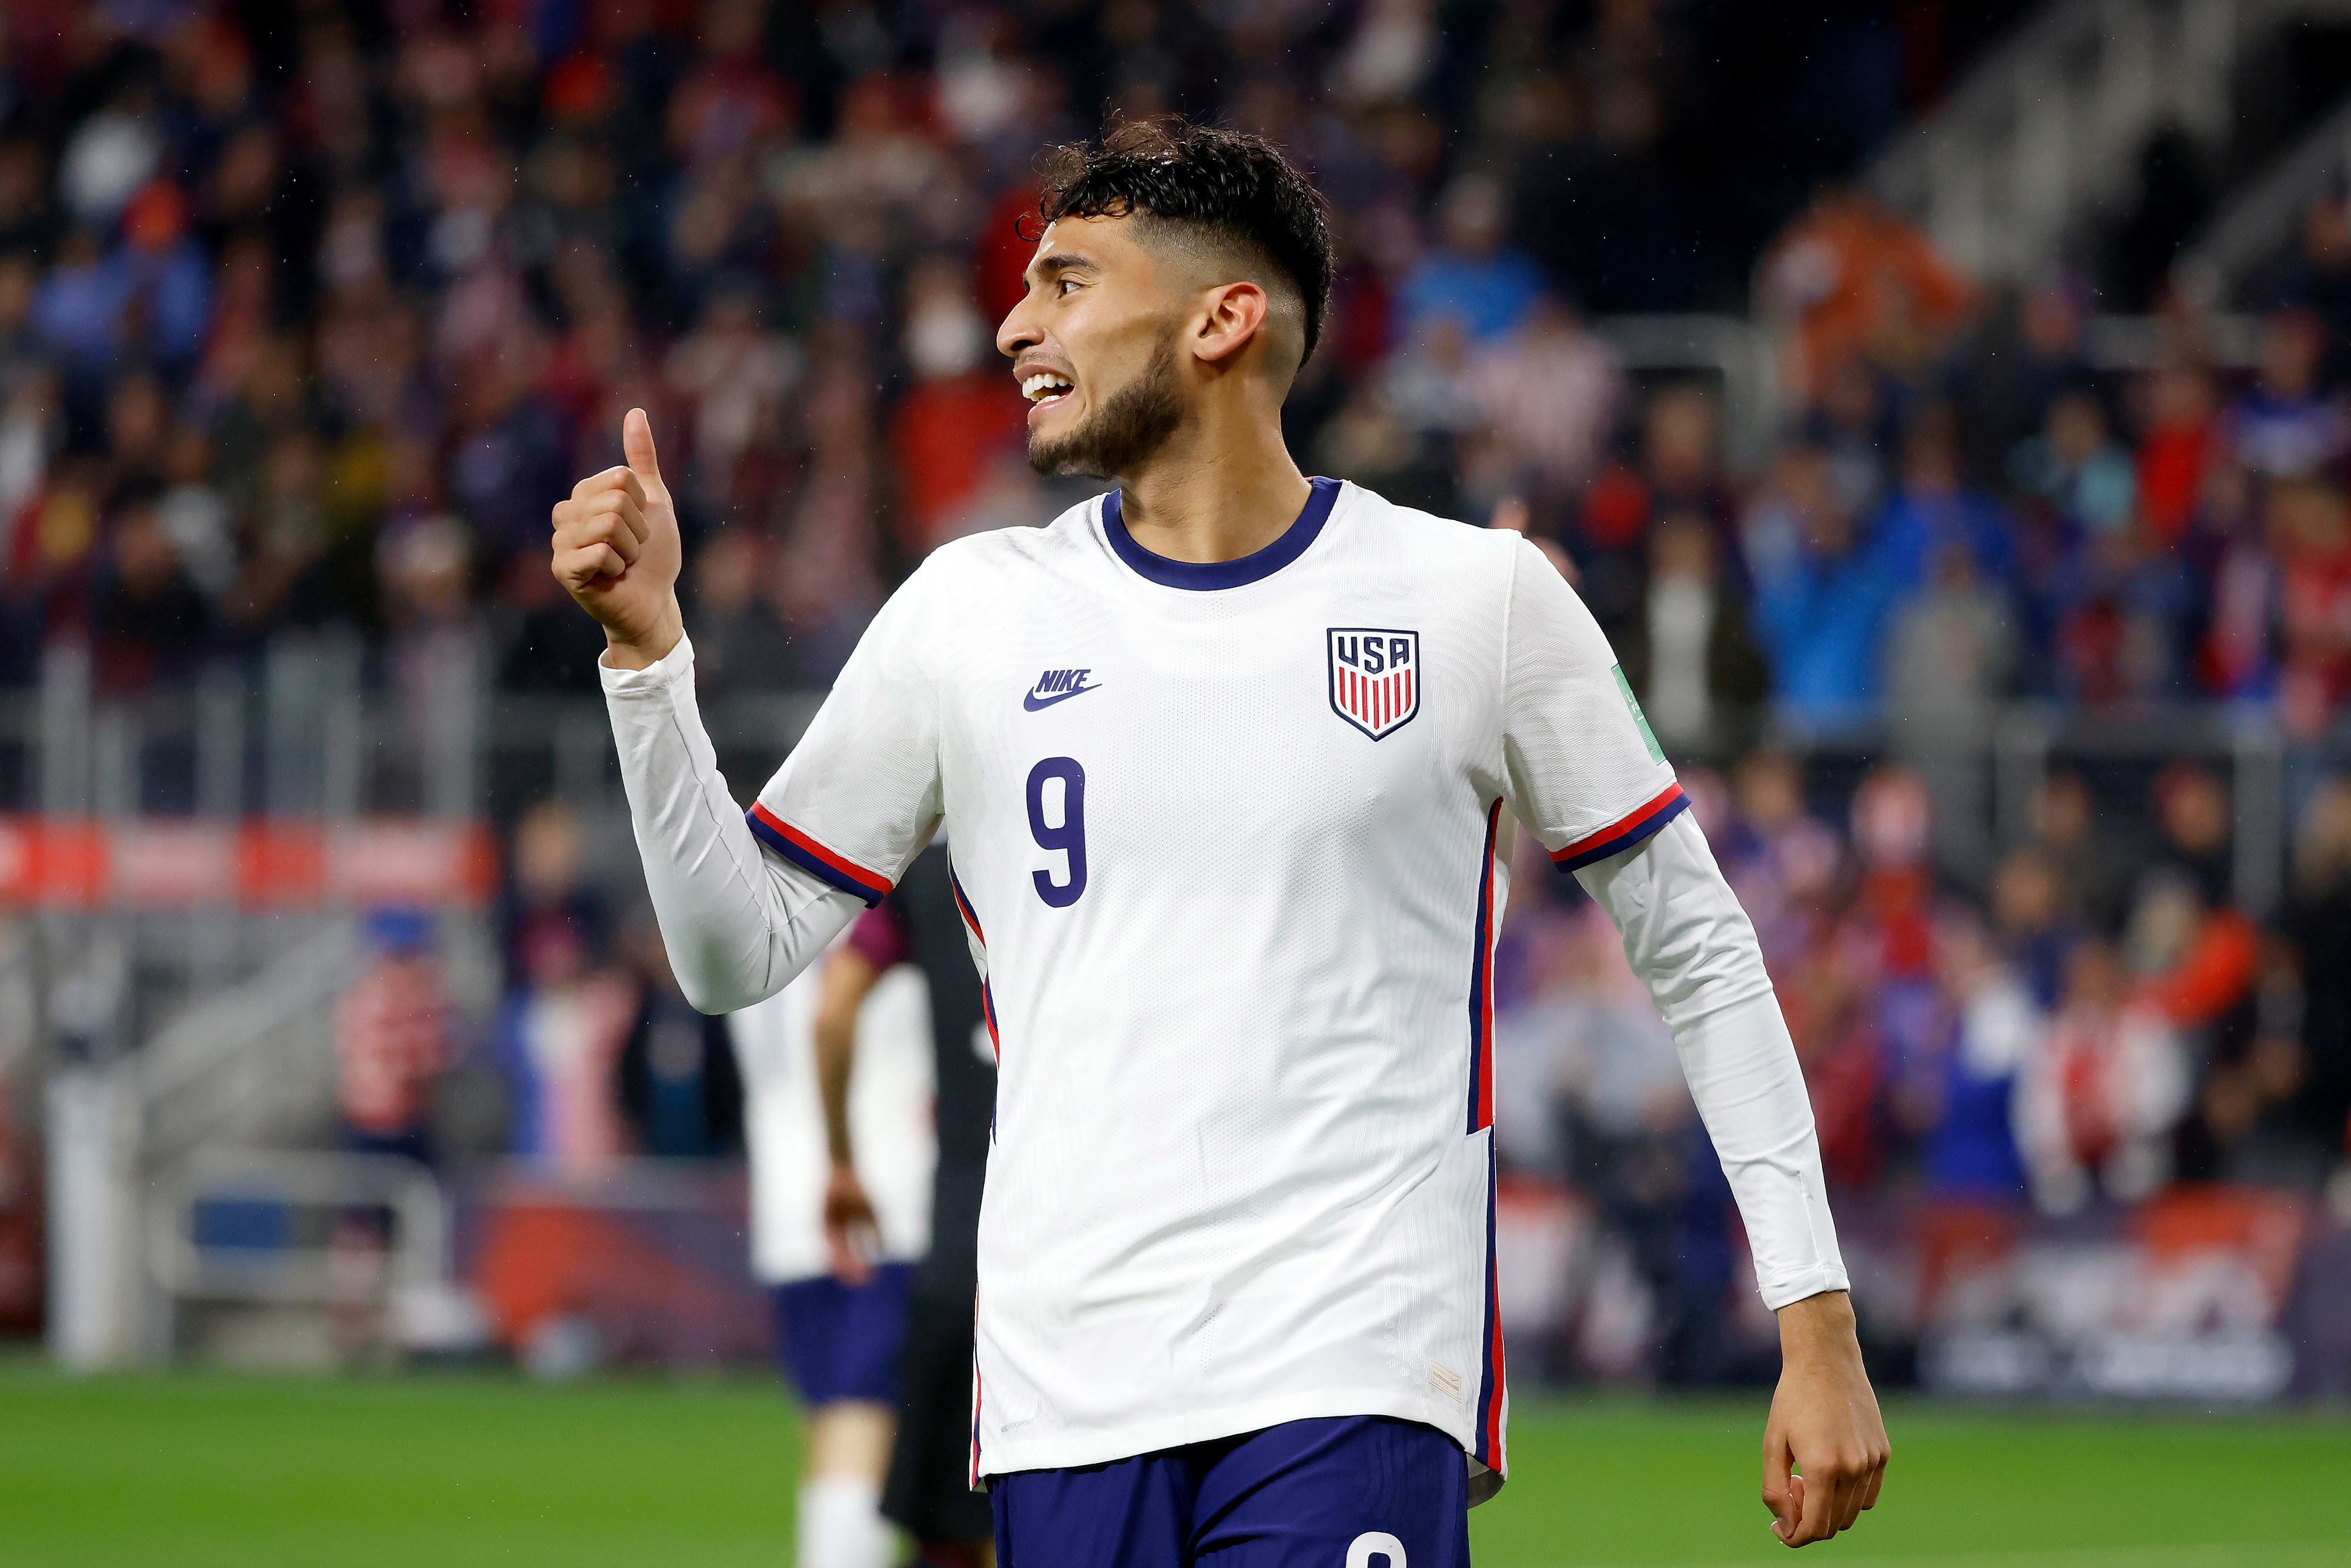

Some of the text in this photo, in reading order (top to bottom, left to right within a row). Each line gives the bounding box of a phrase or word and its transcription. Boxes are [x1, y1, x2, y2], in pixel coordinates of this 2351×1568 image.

[1338, 636, 1409, 675] USA
[1035, 669, 1091, 692] NIKE
[1026, 756, 1087, 908] 9
